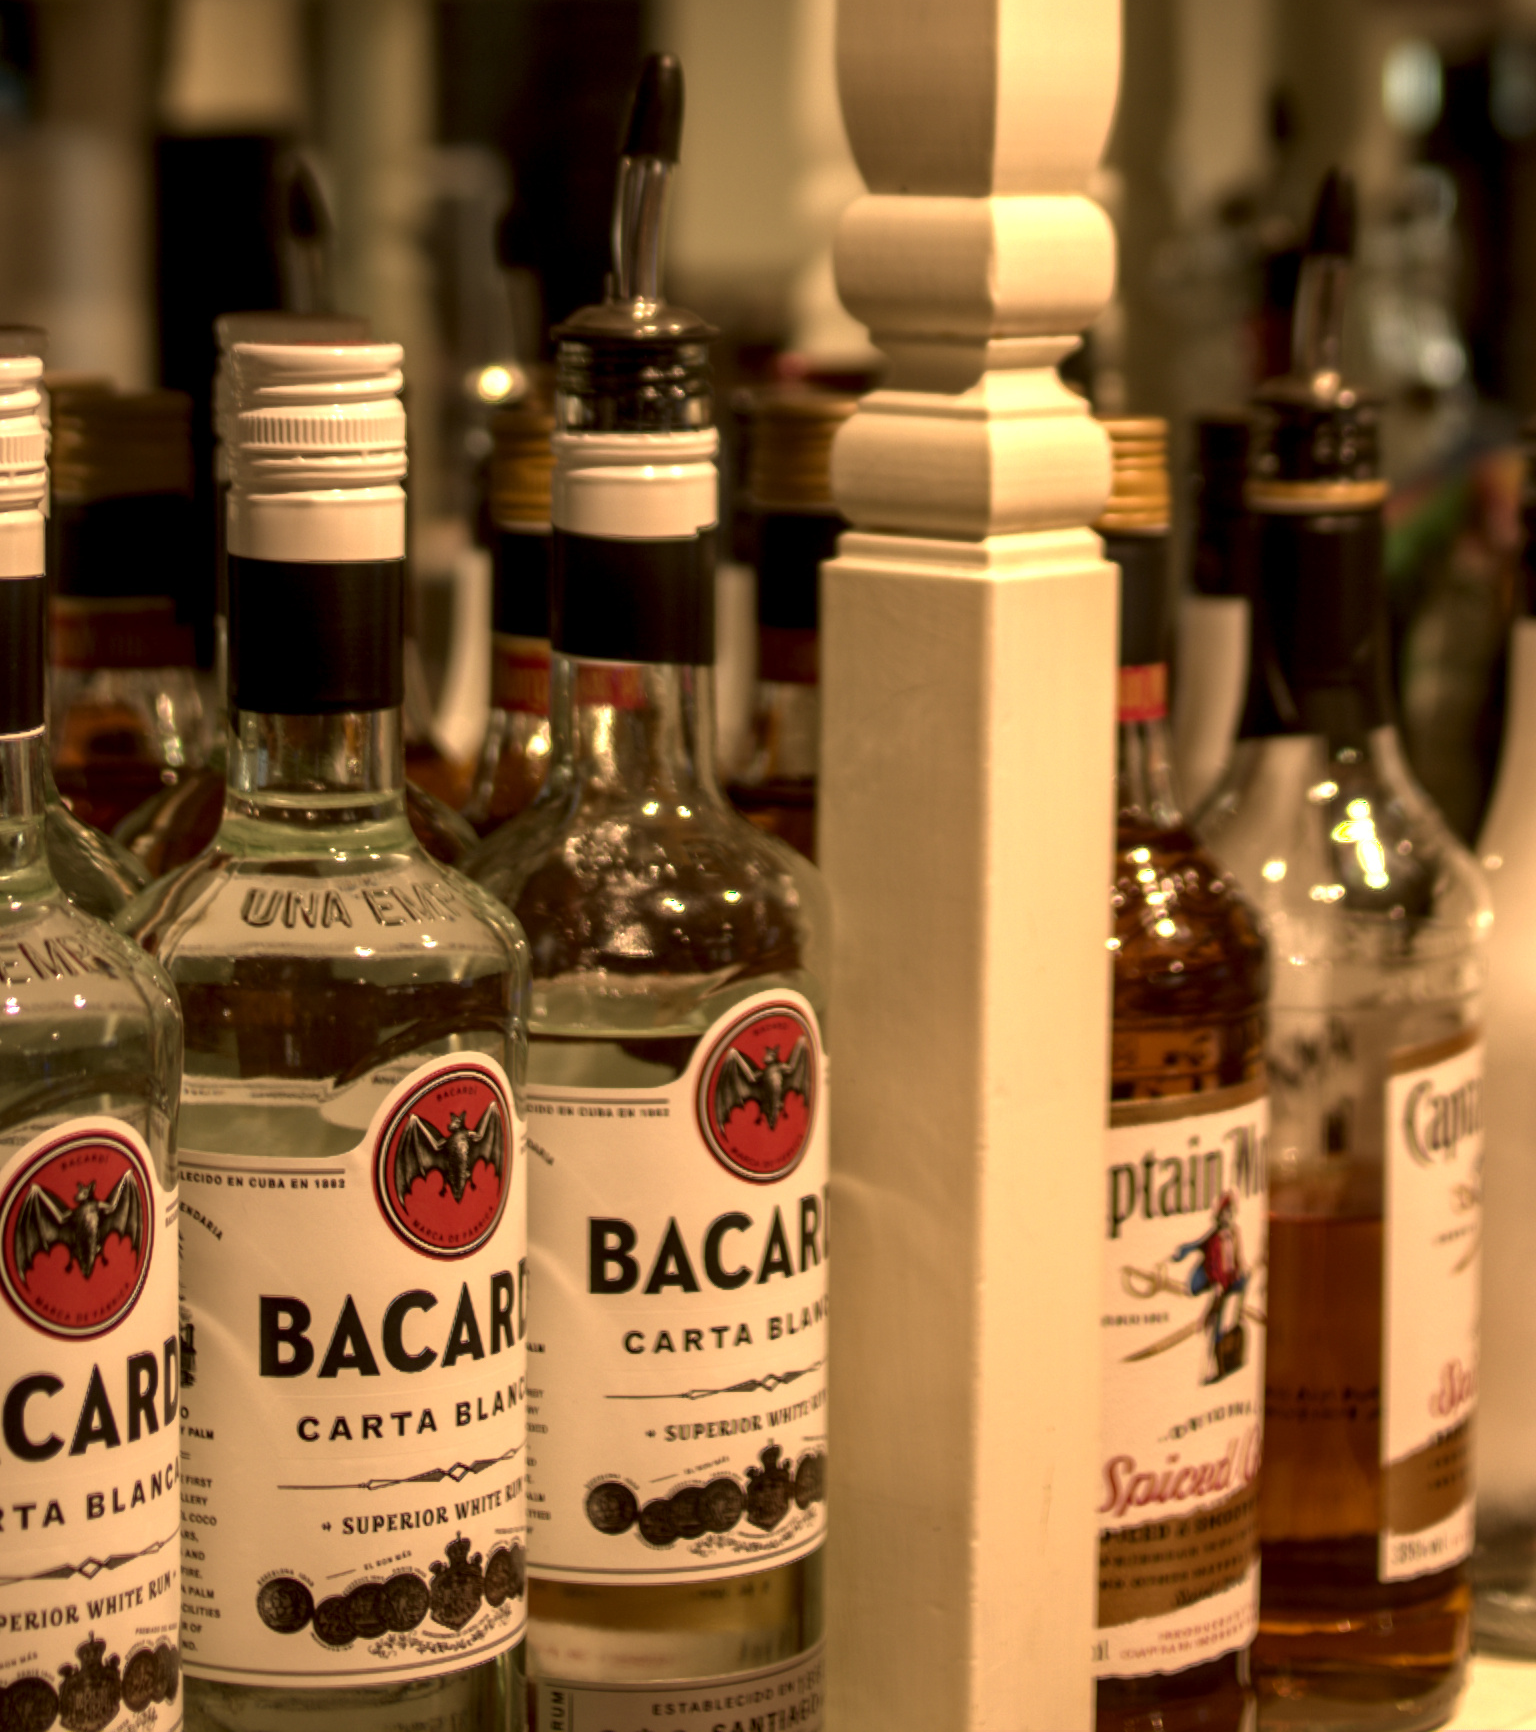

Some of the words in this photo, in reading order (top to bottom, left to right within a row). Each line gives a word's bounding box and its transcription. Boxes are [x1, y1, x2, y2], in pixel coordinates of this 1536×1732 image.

[241, 885, 353, 929] UNA
[558, 1105, 575, 1117] EN
[578, 1106, 614, 1118] CUBA
[617, 1107, 636, 1118] EN
[227, 1176, 245, 1188] EN
[249, 1177, 286, 1189] CUBA
[291, 1178, 309, 1189] EN
[1107, 1134, 1222, 1242] ptain
[622, 1321, 754, 1355] CARTA
[188, 1426, 215, 1440] PALM
[296, 1407, 438, 1443] CARTA
[664, 1413, 764, 1444] SUPERIOR
[766, 1398, 810, 1429] WHITE
[185, 1474, 213, 1489] FIRST
[1097, 1438, 1240, 1518] Spiced
[188, 1512, 218, 1528] COCO
[342, 1505, 449, 1536] SUPERIOR
[454, 1488, 503, 1521] WHITE
[185, 1550, 206, 1562] AND
[86, 1586, 144, 1621] WHITE
[148, 1569, 172, 1601] RUM
[188, 1586, 215, 1600] PALM
[651, 1688, 775, 1716] ESTABLECIDO
